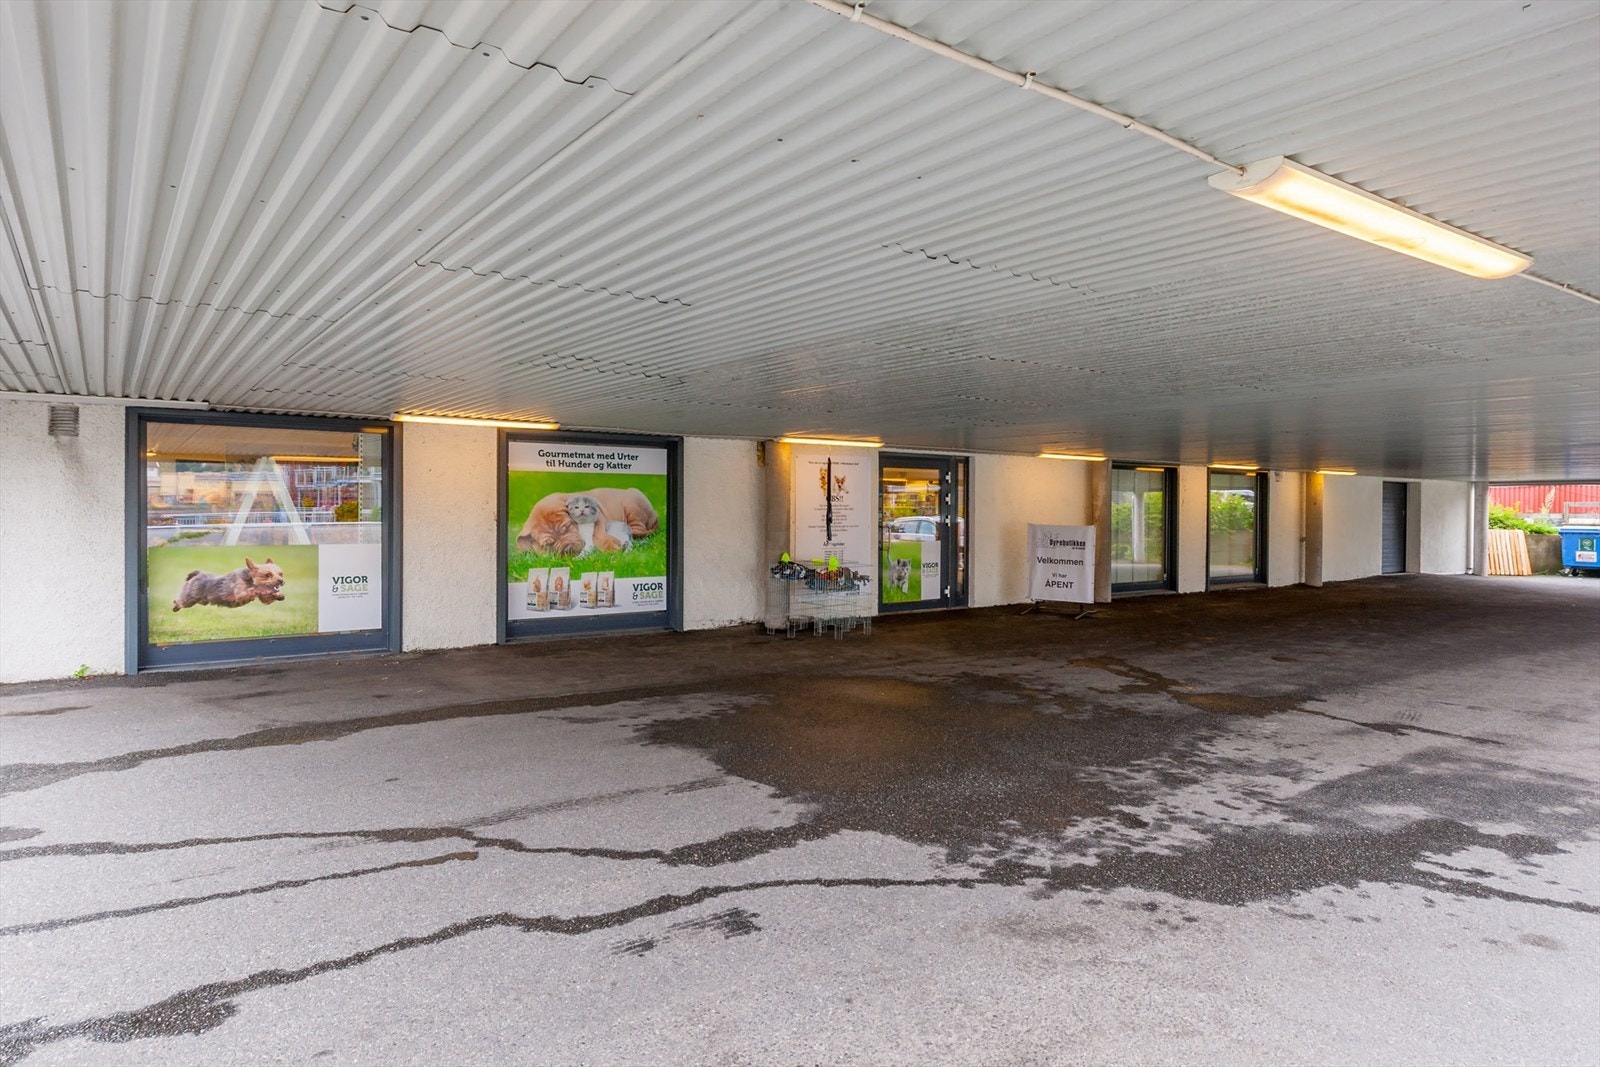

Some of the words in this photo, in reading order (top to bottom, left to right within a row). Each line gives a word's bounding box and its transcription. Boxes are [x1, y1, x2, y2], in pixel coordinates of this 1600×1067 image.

[538, 449, 595, 460] Gourmetmat
[596, 452, 615, 460] med
[617, 452, 639, 461] Urter
[545, 459, 556, 467] til
[557, 460, 591, 469] Hunder
[593, 462, 604, 471] og
[606, 461, 632, 470] Katter
[1036, 556, 1084, 566] Velkommen
[332, 576, 368, 584] VIGOR
[1045, 579, 1074, 588] ÅPENT
[332, 585, 338, 593] &
[340, 584, 368, 592] SAGE
[632, 583, 663, 592] VIGOR
[632, 592, 638, 600] &
[640, 591, 663, 599] SAGE
